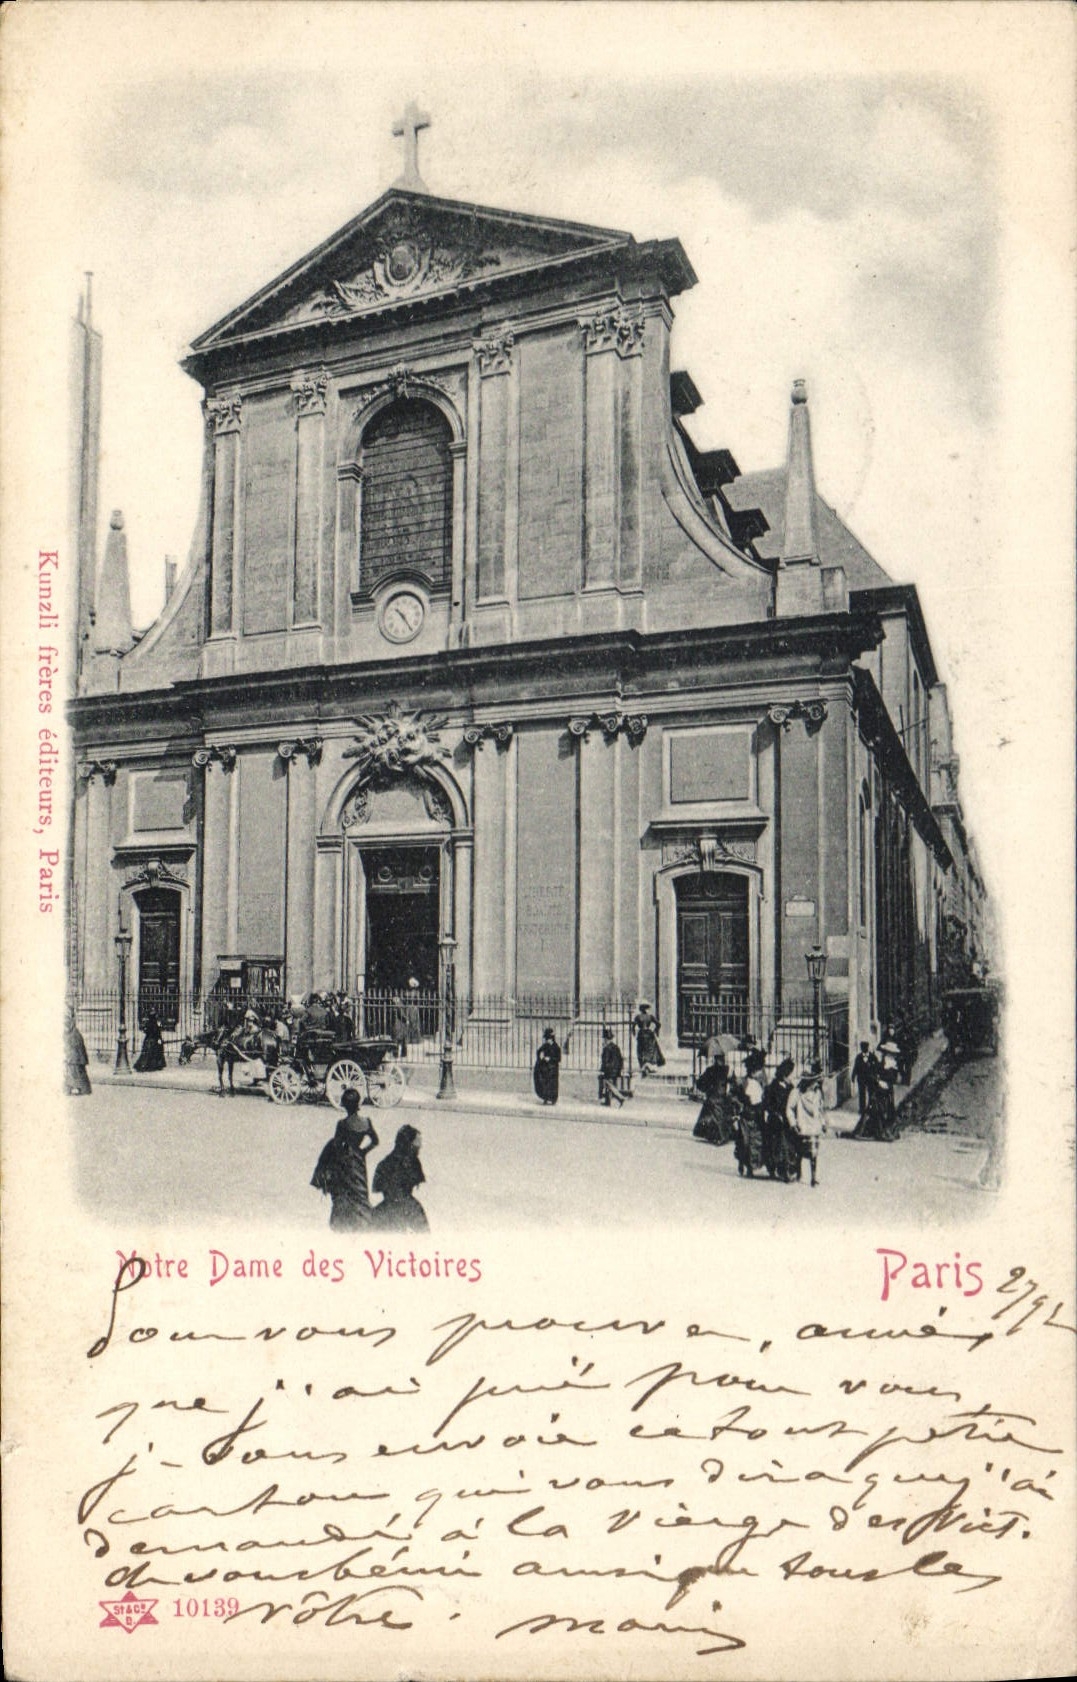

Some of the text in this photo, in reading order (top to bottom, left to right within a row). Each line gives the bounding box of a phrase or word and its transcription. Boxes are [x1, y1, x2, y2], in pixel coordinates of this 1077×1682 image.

[255, 1327, 396, 1348] vous
[624, 1361, 812, 1412] pour
[838, 1379, 961, 1402] vous
[415, 1469, 532, 1528] qui
[548, 1476, 674, 1491] vous
[507, 1505, 568, 1538] la
